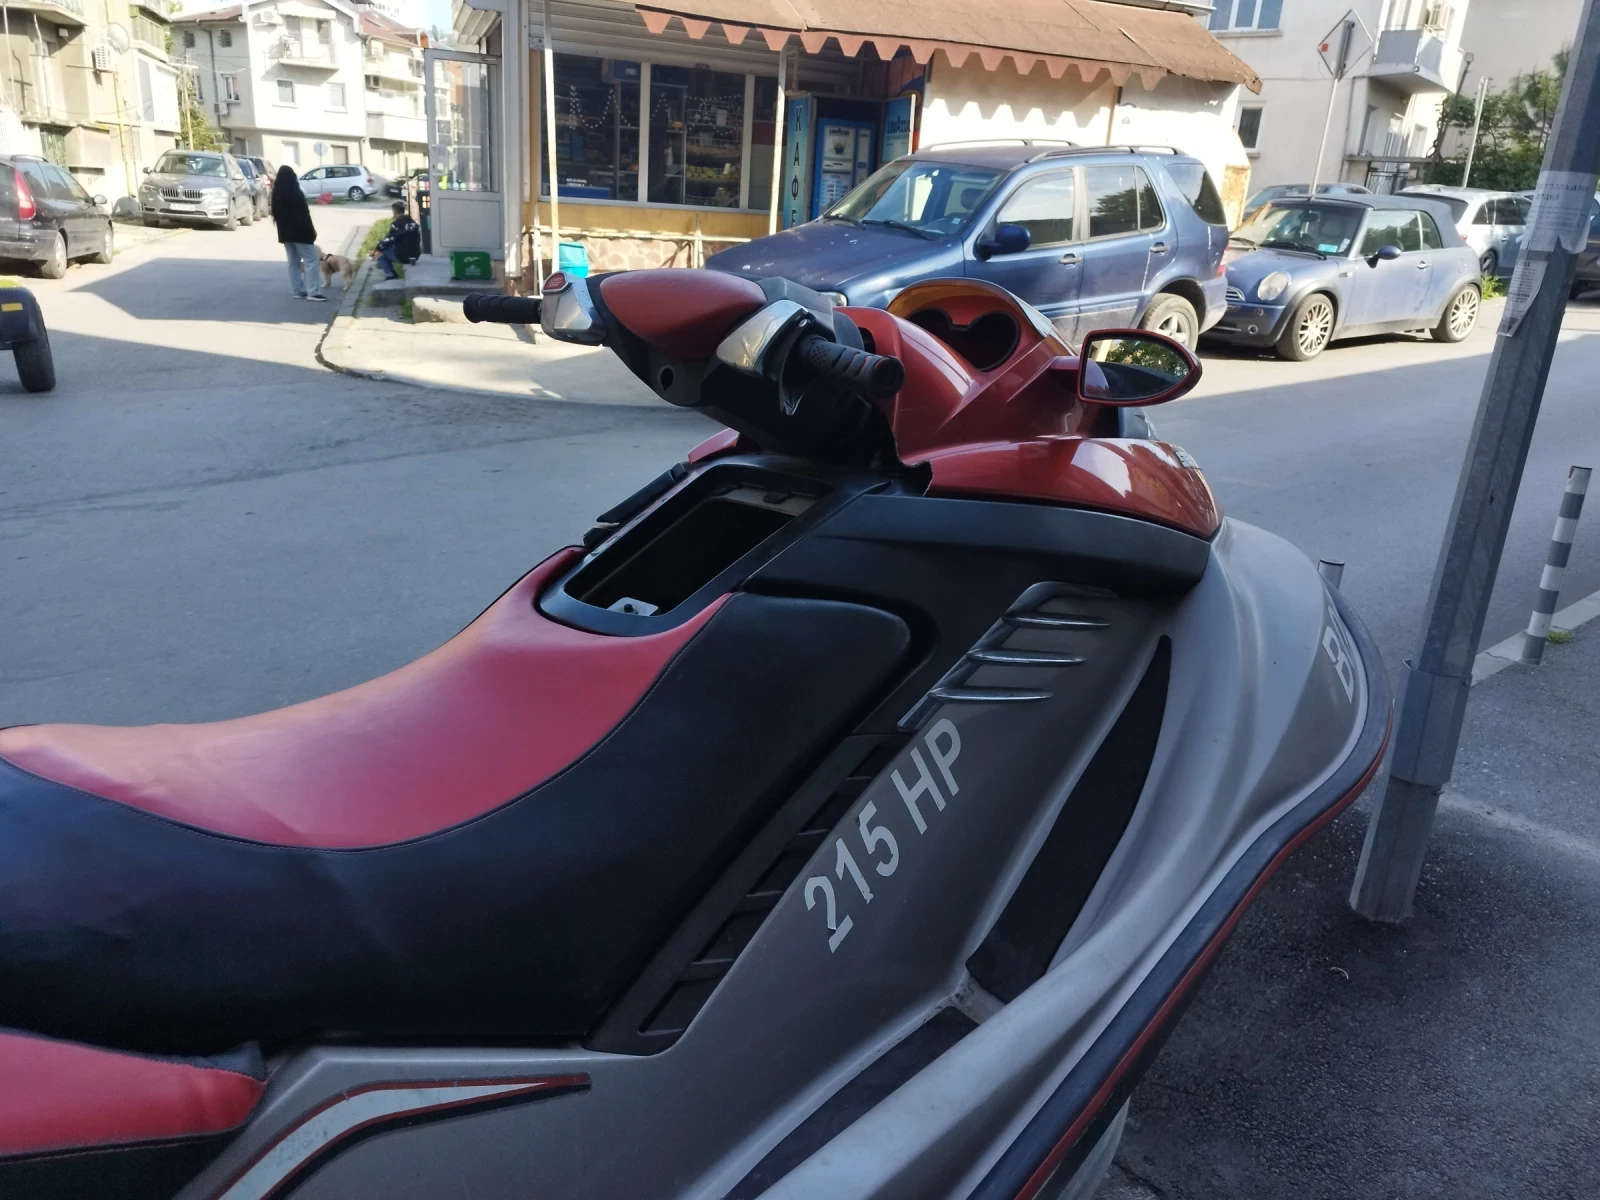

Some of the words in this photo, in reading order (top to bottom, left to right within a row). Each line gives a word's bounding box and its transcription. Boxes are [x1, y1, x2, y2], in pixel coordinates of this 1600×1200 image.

[790, 105, 803, 228] КАФЕ
[804, 800, 899, 953] 215
[890, 718, 961, 835] HP
